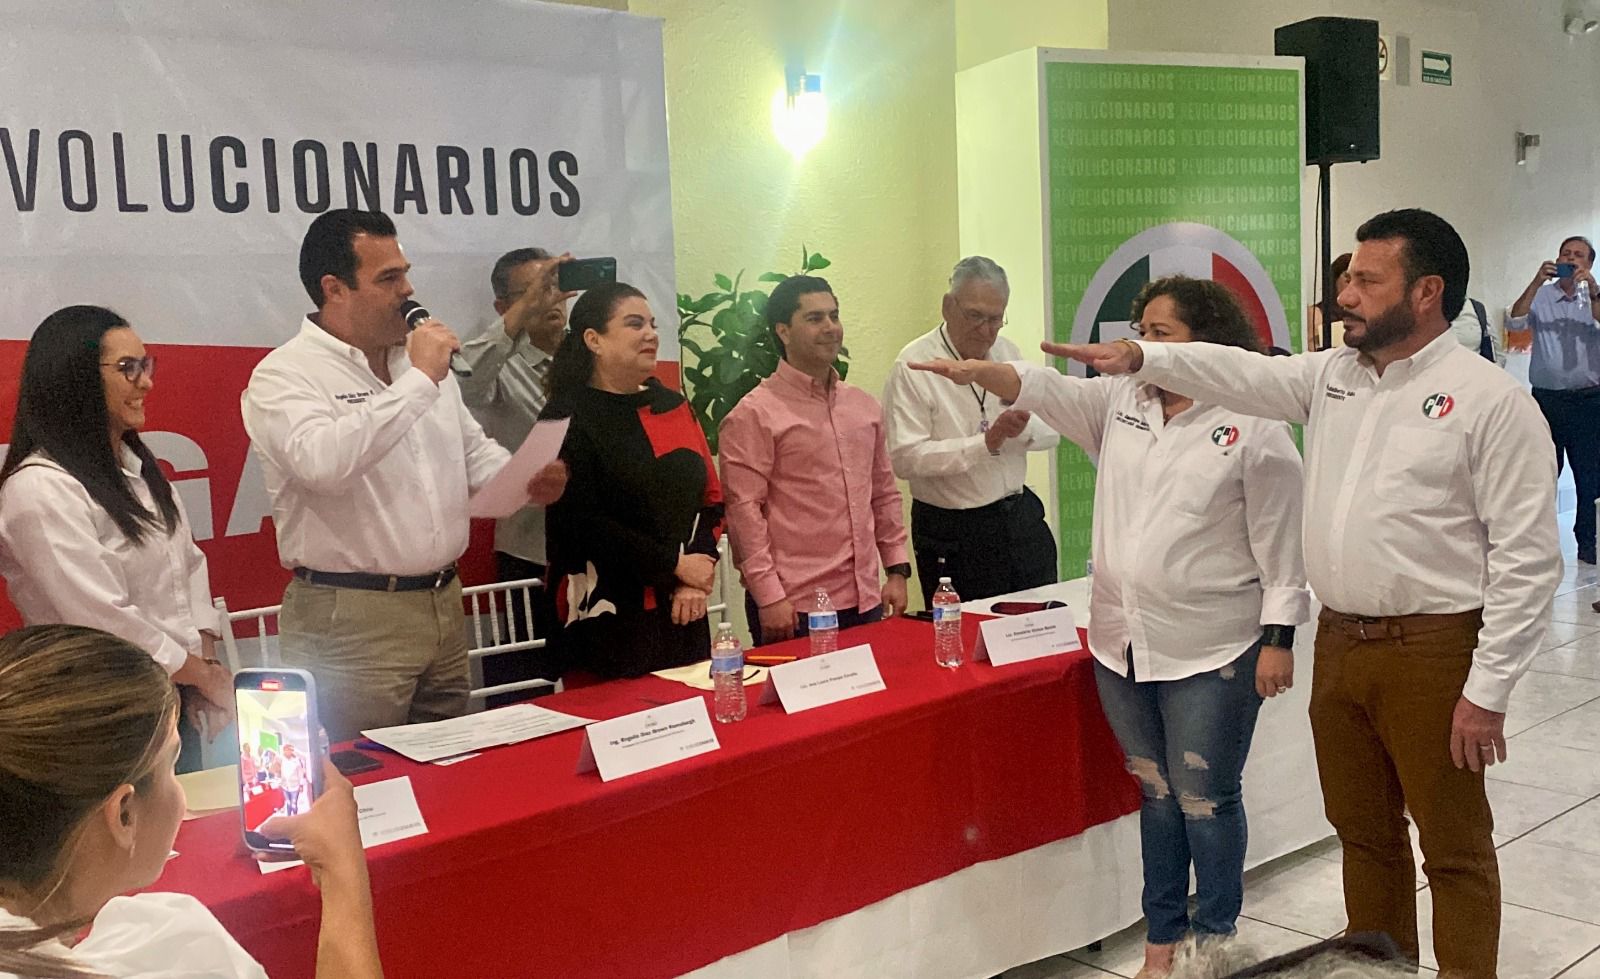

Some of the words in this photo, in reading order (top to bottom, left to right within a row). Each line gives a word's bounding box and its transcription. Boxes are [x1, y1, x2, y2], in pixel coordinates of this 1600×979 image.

[1053, 129, 1175, 146] REVOLUCIONARIOS
[1180, 129, 1296, 146] REVOLUCIONARIOS
[1054, 158, 1176, 177] REVOLUCIONARIOS
[1181, 157, 1296, 175] REVOLUCIONARIOS
[1055, 187, 1176, 206] REVOLUCIONARIOS
[1182, 185, 1297, 205] REVOLUCIONARIOS
[1424, 395, 1449, 413] PRI
[1213, 426, 1237, 442] PRI
